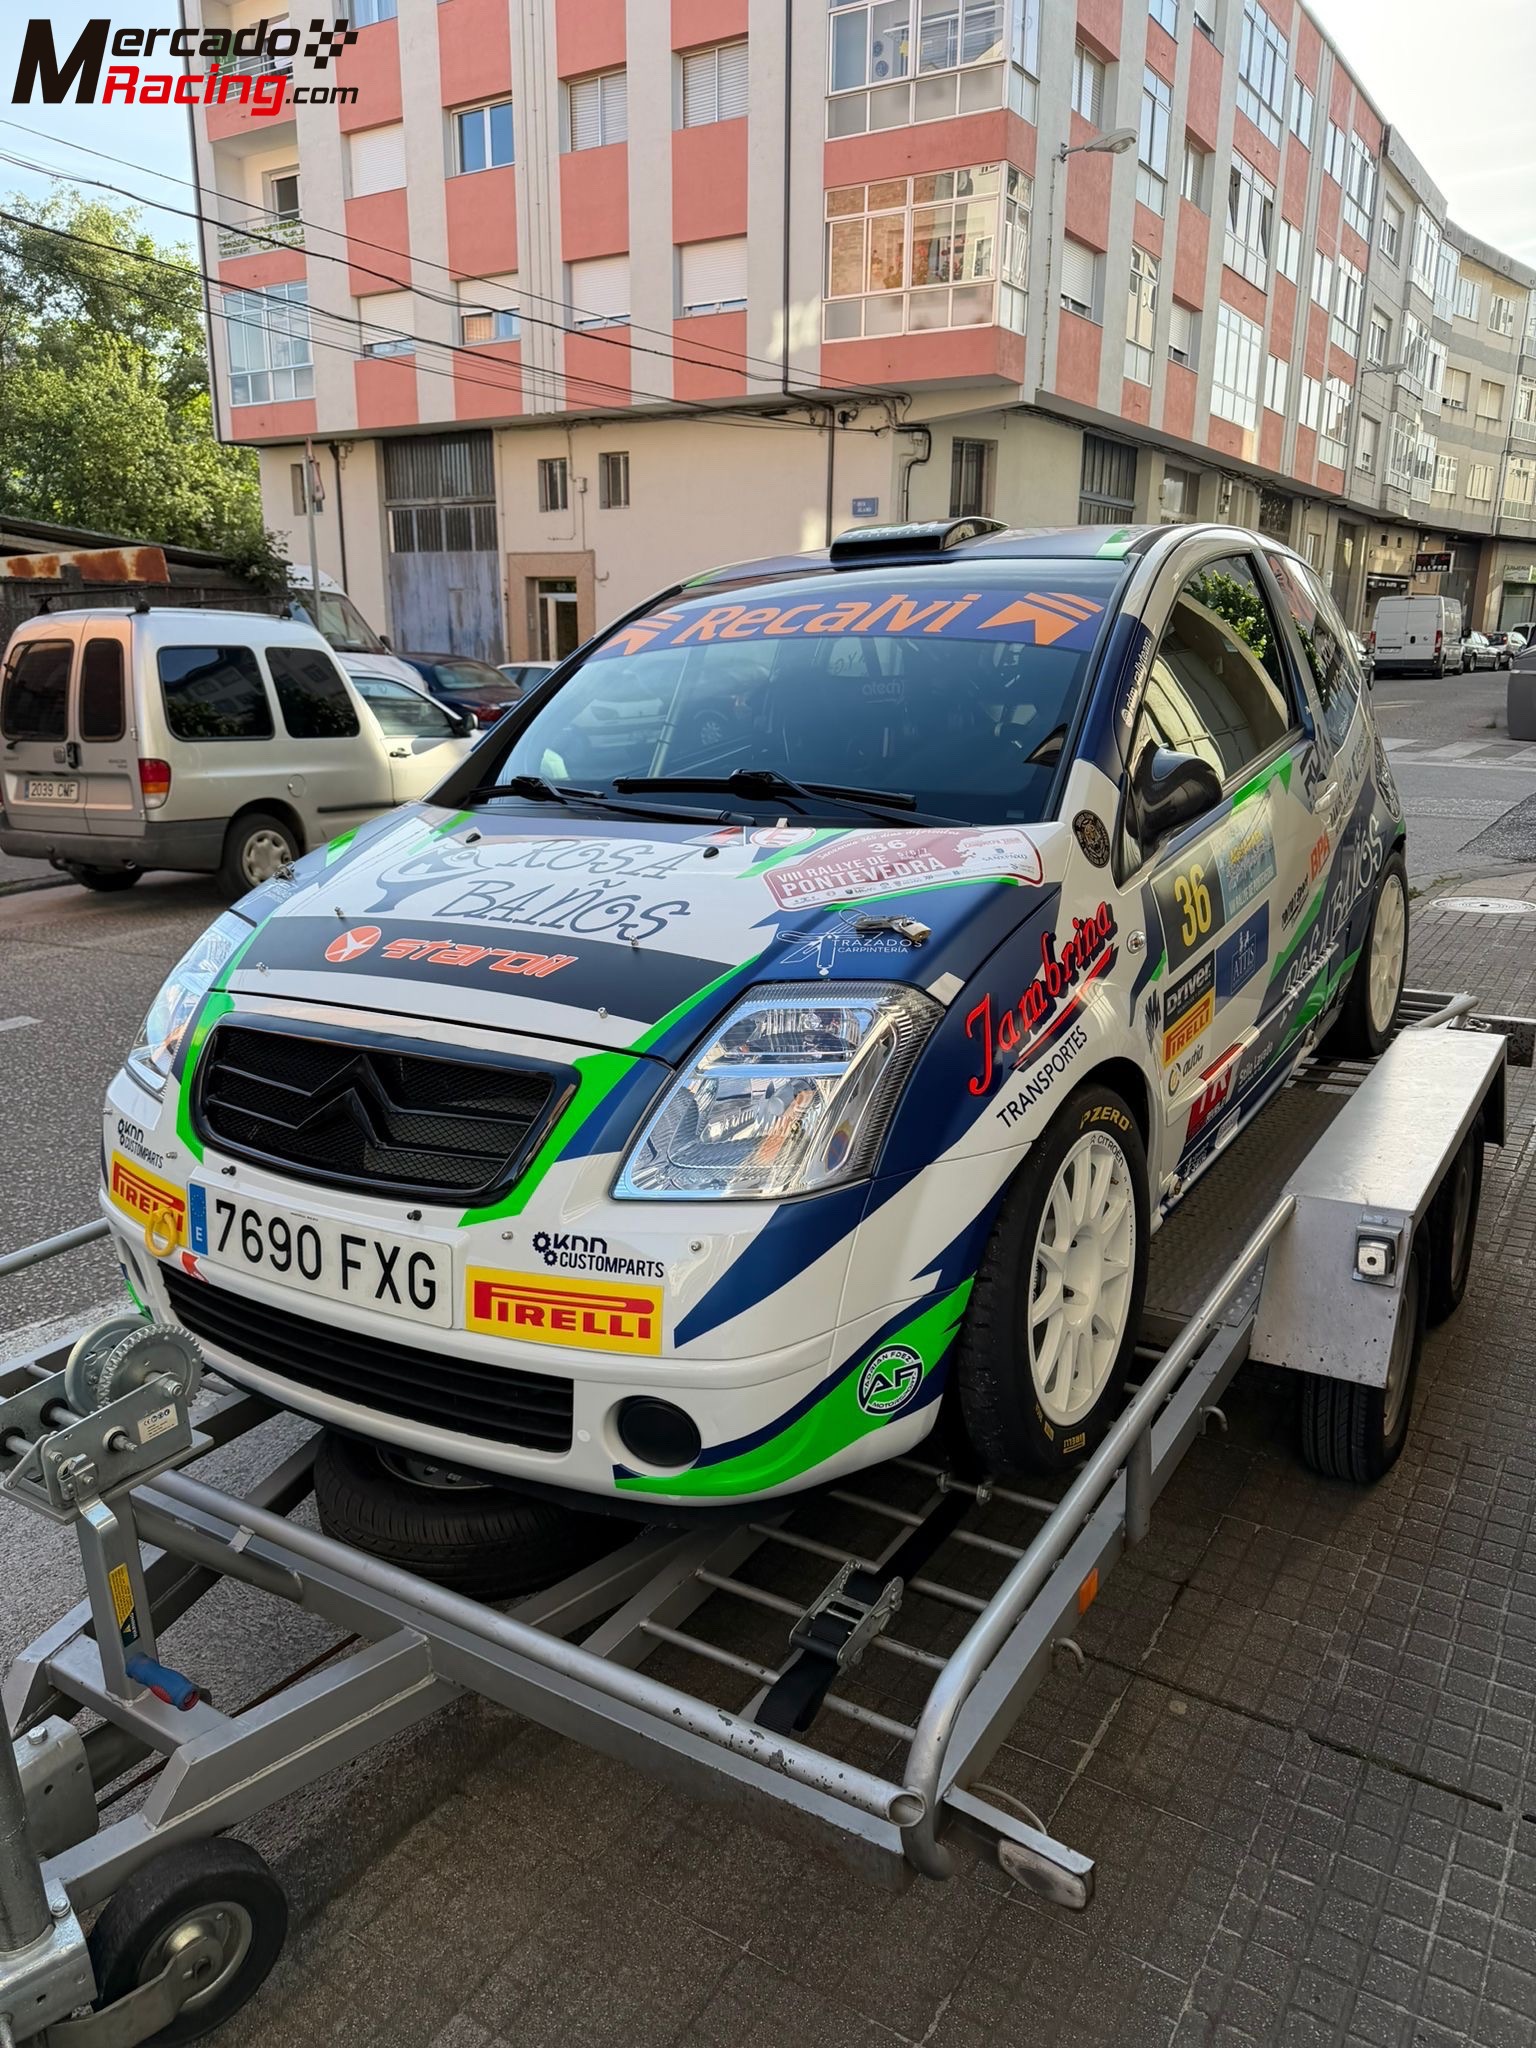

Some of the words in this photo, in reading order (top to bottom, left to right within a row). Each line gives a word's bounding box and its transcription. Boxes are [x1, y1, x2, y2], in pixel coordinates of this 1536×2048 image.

[670, 592, 984, 646] Recalvi
[31, 782, 54, 797] 2039
[868, 839, 907, 853] 36
[777, 872, 803, 883] VIII
[805, 860, 864, 878] RALLYE
[866, 854, 888, 866] DE
[781, 856, 946, 897] PONTEVEDRA
[1174, 863, 1212, 947] 36
[832, 938, 922, 948] TRAZADOS
[1165, 997, 1210, 1062] PIRELLI
[996, 1025, 1088, 1129] TRANSPORTES
[124, 1136, 164, 1169] CUSTOMPARTS
[195, 1227, 203, 1242] E
[216, 1198, 322, 1281] 7690
[340, 1233, 436, 1311] FXG
[559, 1251, 665, 1279] CUSTOMPARTS
[474, 1280, 655, 1339] PIRELLI
[890, 1351, 912, 1363] FDEZ
